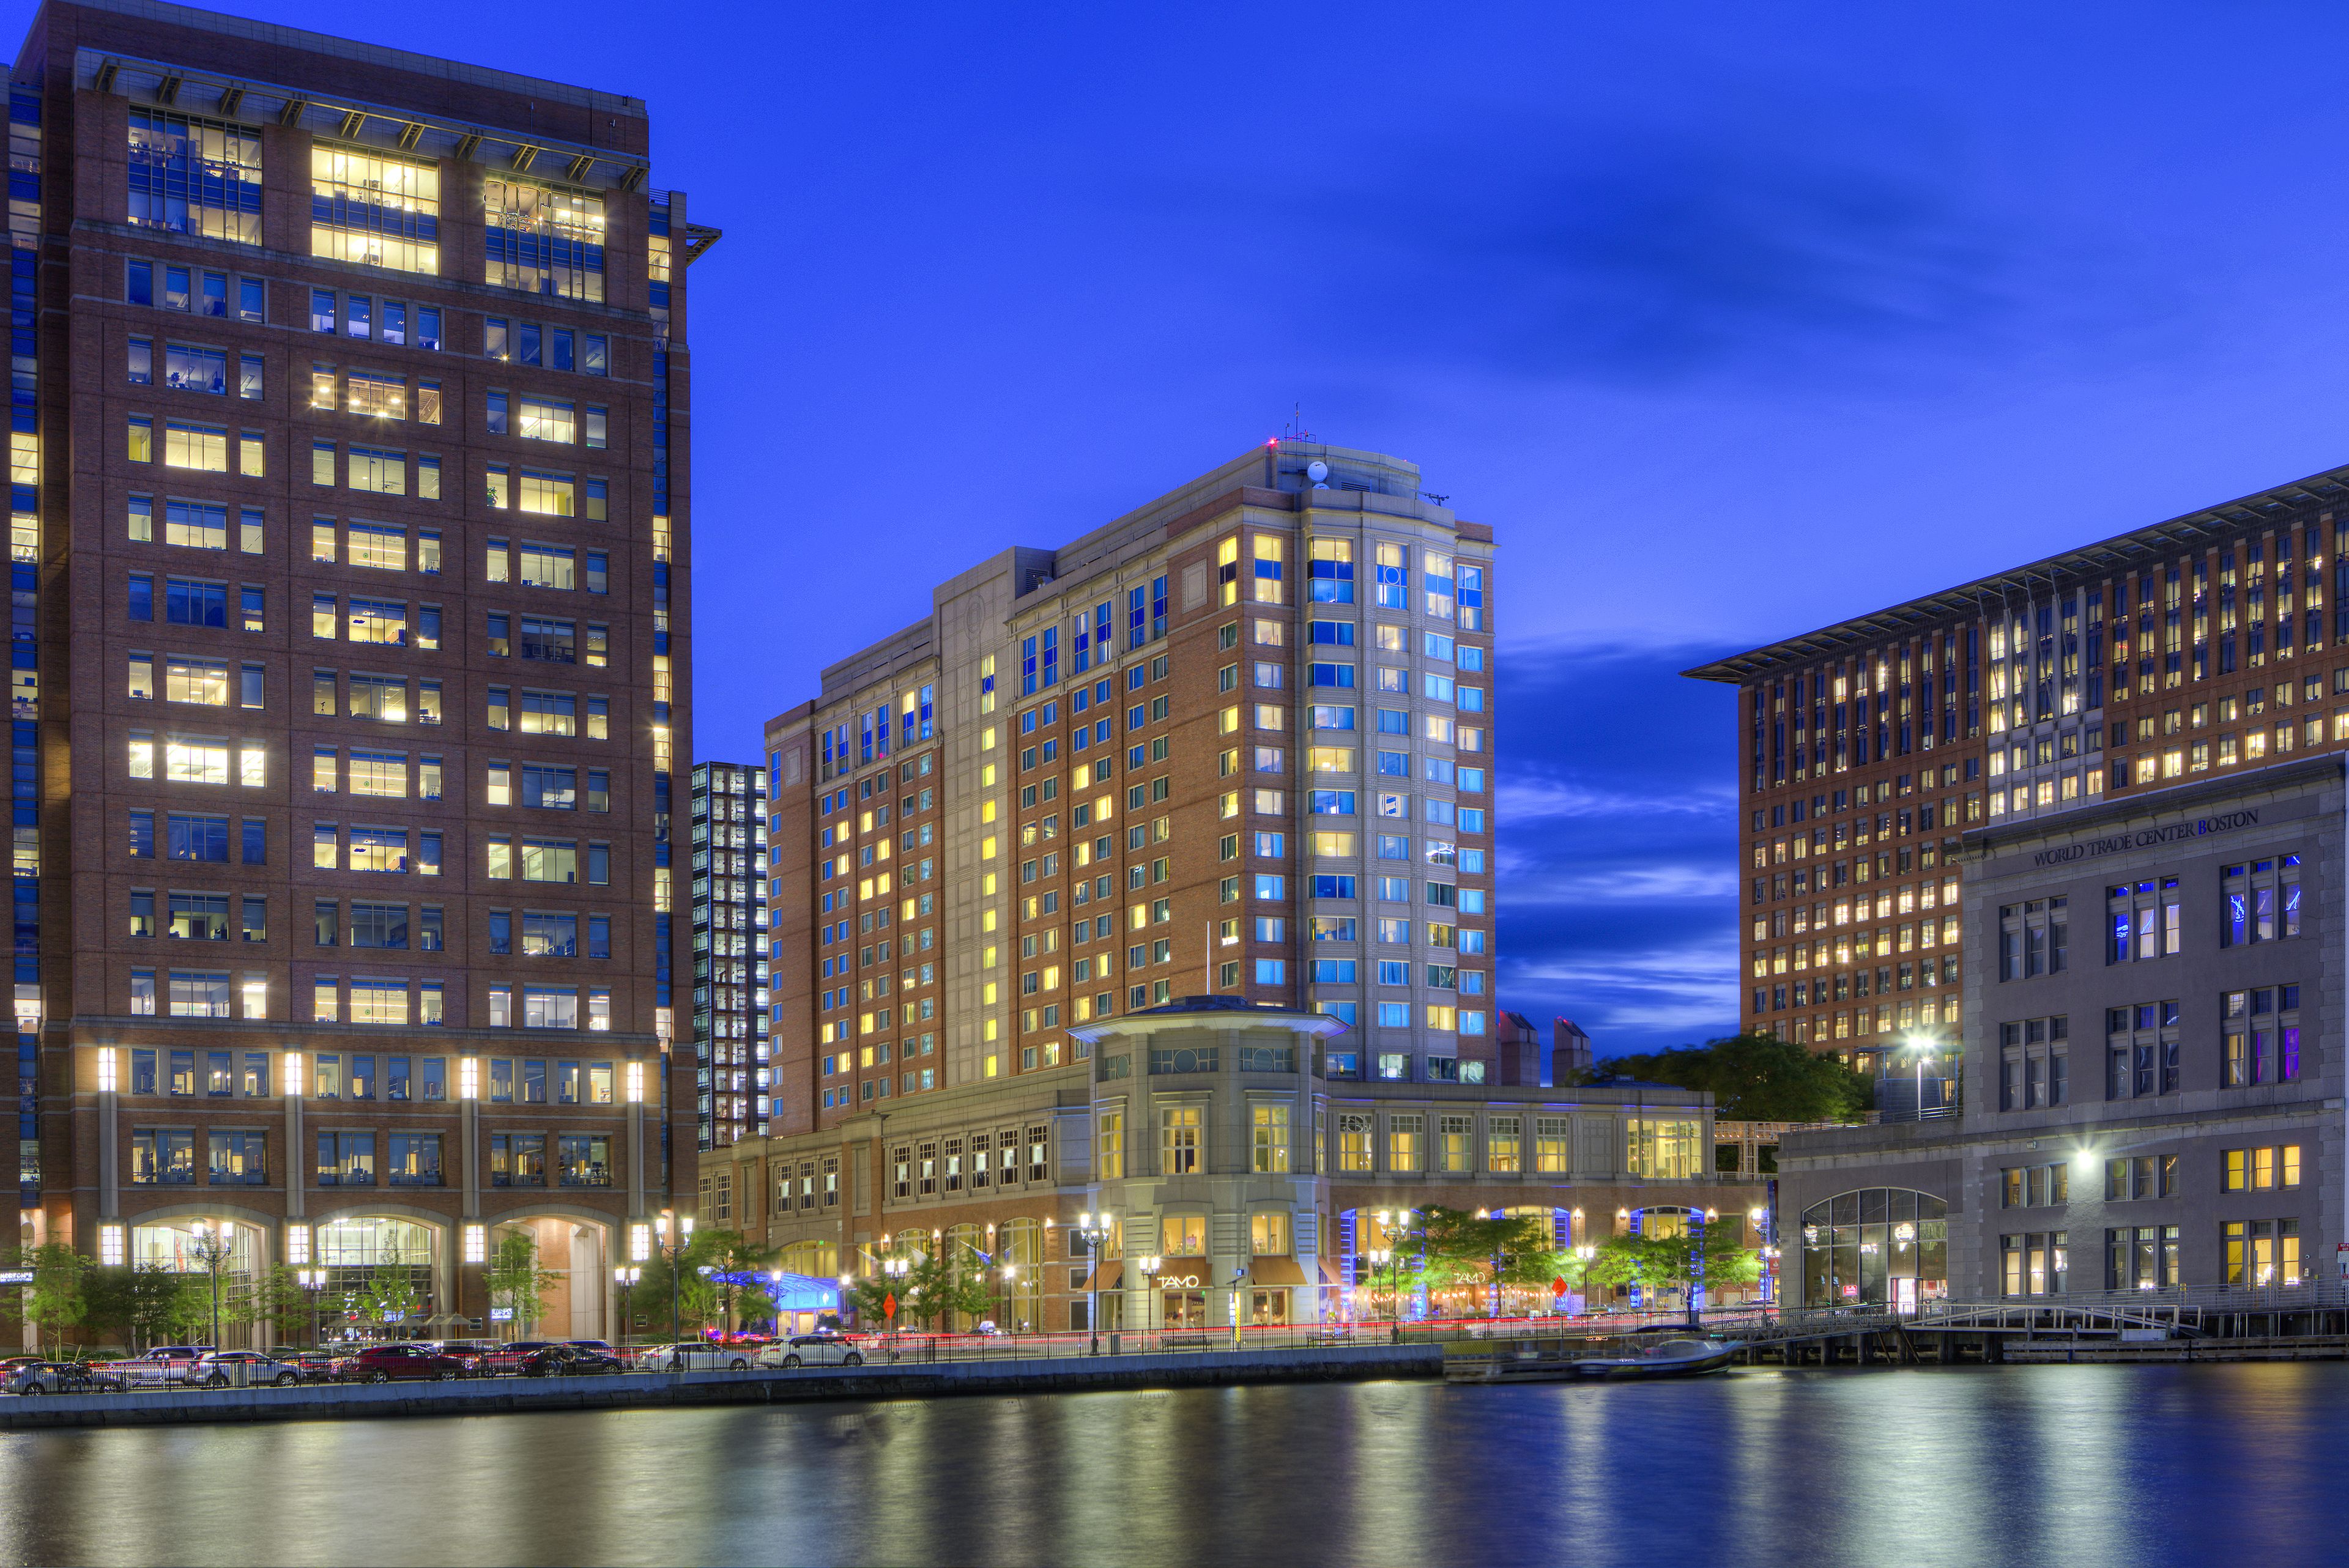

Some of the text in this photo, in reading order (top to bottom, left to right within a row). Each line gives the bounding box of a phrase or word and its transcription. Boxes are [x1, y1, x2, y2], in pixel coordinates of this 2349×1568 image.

[2035, 808, 2259, 867] WORLD TRADE CENTER BOSTON
[1157, 1275, 1199, 1289] TAMO
[1454, 1272, 1485, 1284] TAMO
